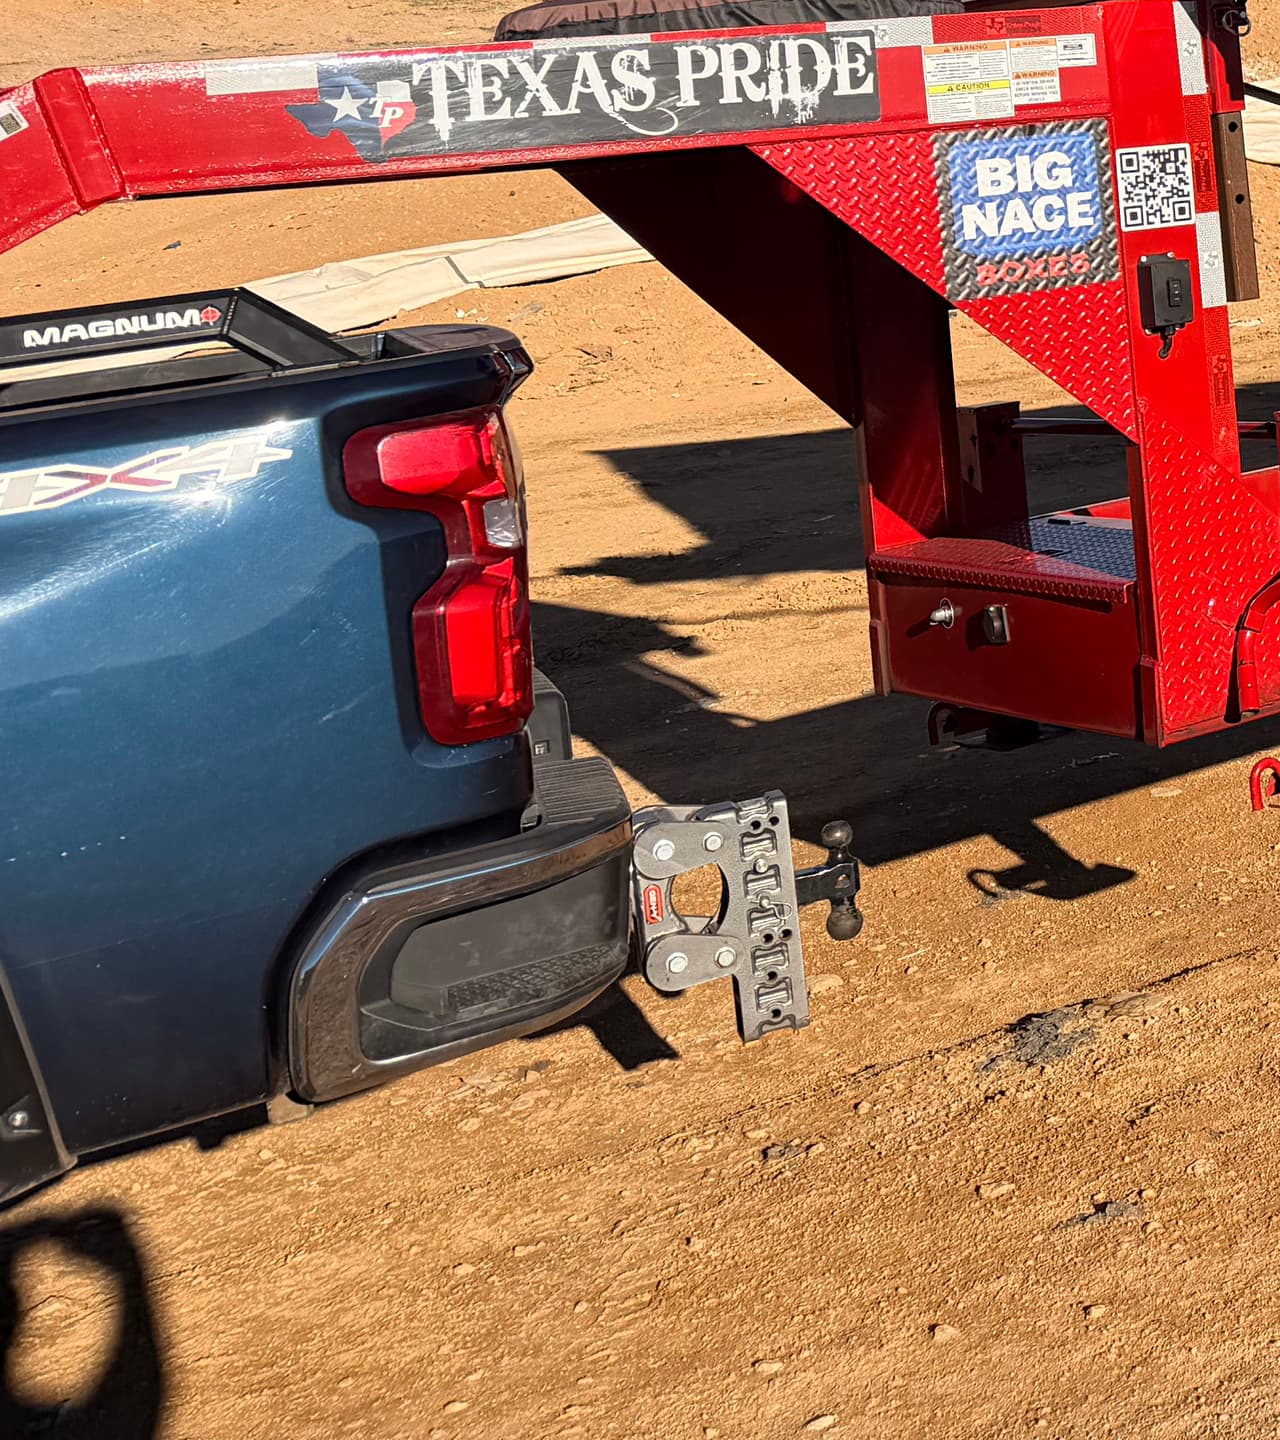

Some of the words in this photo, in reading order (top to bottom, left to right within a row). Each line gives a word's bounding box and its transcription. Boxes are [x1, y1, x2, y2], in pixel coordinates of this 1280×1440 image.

[952, 43, 988, 52] WARNING
[1022, 39, 1049, 47] WARNING
[411, 49, 678, 147] TEXAS
[675, 35, 876, 117] PRIDE
[956, 82, 990, 91] CAUTION
[1021, 70, 1055, 78] WARNING
[975, 151, 1074, 197] BIG
[961, 192, 1095, 241] NACE
[976, 253, 1091, 287] BOXES
[23, 309, 203, 348] MAGNUM
